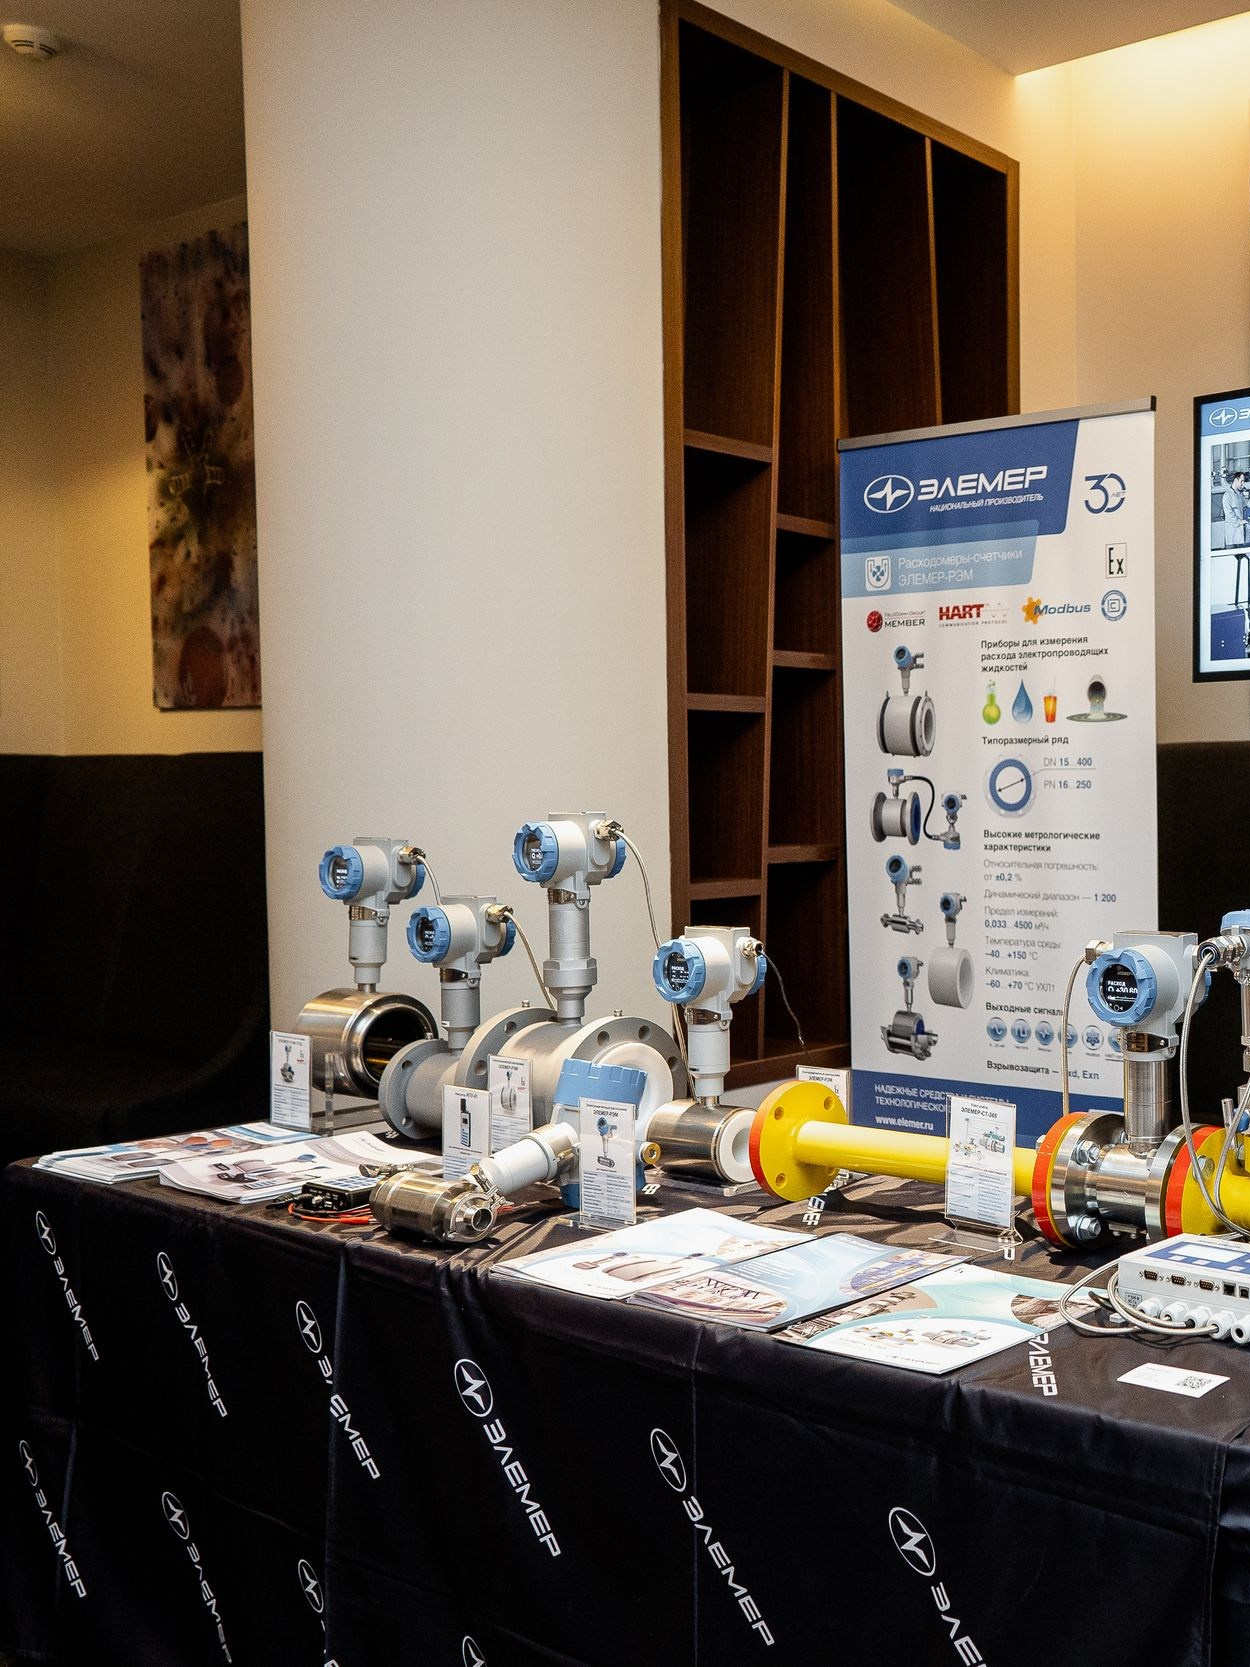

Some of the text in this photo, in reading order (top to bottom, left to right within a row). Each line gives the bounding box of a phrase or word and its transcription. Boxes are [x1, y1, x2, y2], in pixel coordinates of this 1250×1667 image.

[917, 465, 1048, 500] ЭЛЕМЕР
[929, 493, 1044, 512] НАЦИОНАЛЬНЫЙ ПРОИЗВОДИТЕЛЬ
[1108, 547, 1124, 575] Ex
[898, 570, 974, 588] ЭЛЕМЕР-РЭМ
[938, 603, 985, 621] HART
[1034, 602, 1092, 616] Modbus
[884, 618, 925, 628] MEMBER
[981, 636, 1089, 650] Приборы для измерения
[981, 647, 1109, 662] расхода электропроводящих
[981, 663, 1028, 673] жидкостей
[982, 736, 1069, 746] Типоразмерный ряд
[983, 829, 1100, 841] Высокие метрологические
[983, 843, 1051, 853] характеристики
[984, 906, 1015, 916] Предел
[985, 936, 1036, 948] Температура
[985, 1002, 1032, 1014] Выходные
[986, 1060, 1050, 1075] Взрывозащита
[874, 1084, 917, 1097] НАДЕЖНЫЕ
[875, 1096, 947, 1112] ТЕХНОЛОГИЧЕСКО
[875, 1116, 934, 1131] www.elemer.ru
[54, 1256, 99, 1361] ЭЛЕМЕР
[174, 1302, 228, 1417] ЭЛЕМЕР
[483, 1418, 561, 1557] ЭЛЕМЕР
[35, 1488, 87, 1598] ЭЛЕМЕР
[682, 1495, 775, 1646] ЭЛЕМЕР
[186, 1542, 232, 1664] ЭЛЕМЕР
[930, 1581, 988, 1667] ЭЛЕ
